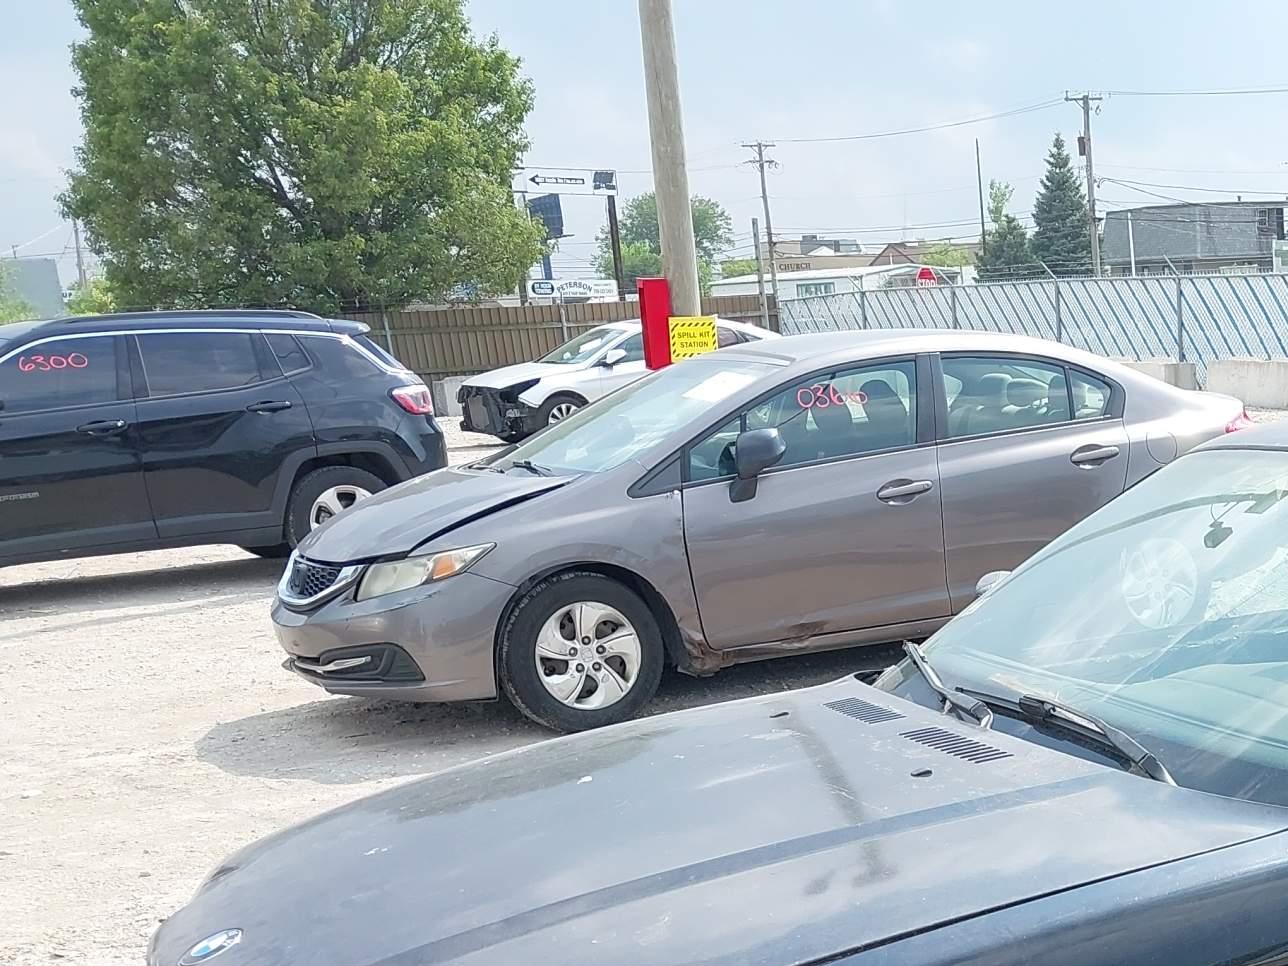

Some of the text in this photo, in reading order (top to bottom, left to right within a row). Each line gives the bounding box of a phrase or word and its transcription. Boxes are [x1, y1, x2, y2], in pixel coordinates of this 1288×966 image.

[779, 262, 811, 272] CHURCH
[556, 281, 593, 293] PETERSON
[677, 330, 711, 339] SPILL KIT
[680, 341, 709, 349] STATION
[18, 352, 88, 371] 6300
